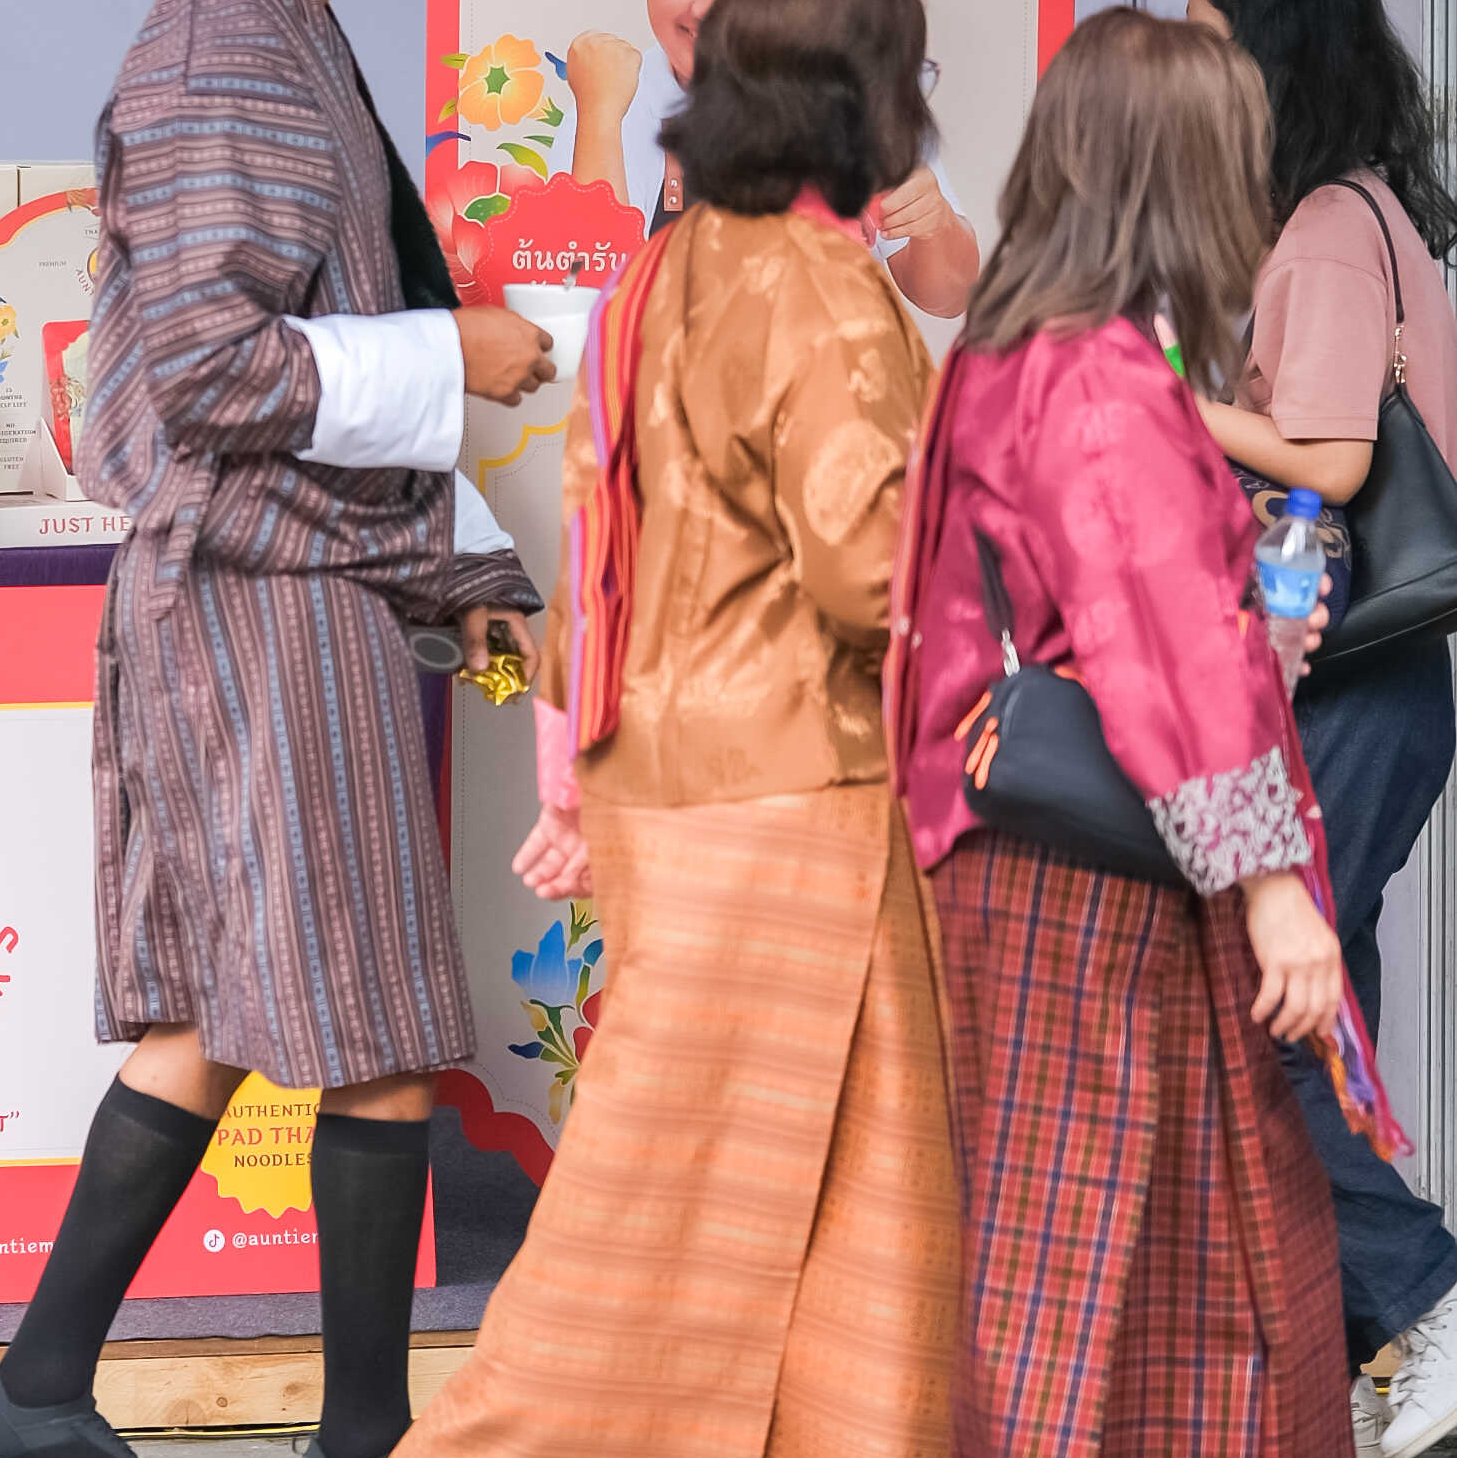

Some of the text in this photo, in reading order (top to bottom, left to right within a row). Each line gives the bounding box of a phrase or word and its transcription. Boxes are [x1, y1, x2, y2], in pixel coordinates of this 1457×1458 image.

[38, 515, 132, 535] JUST HE
[216, 1126, 316, 1147] PAD THA
